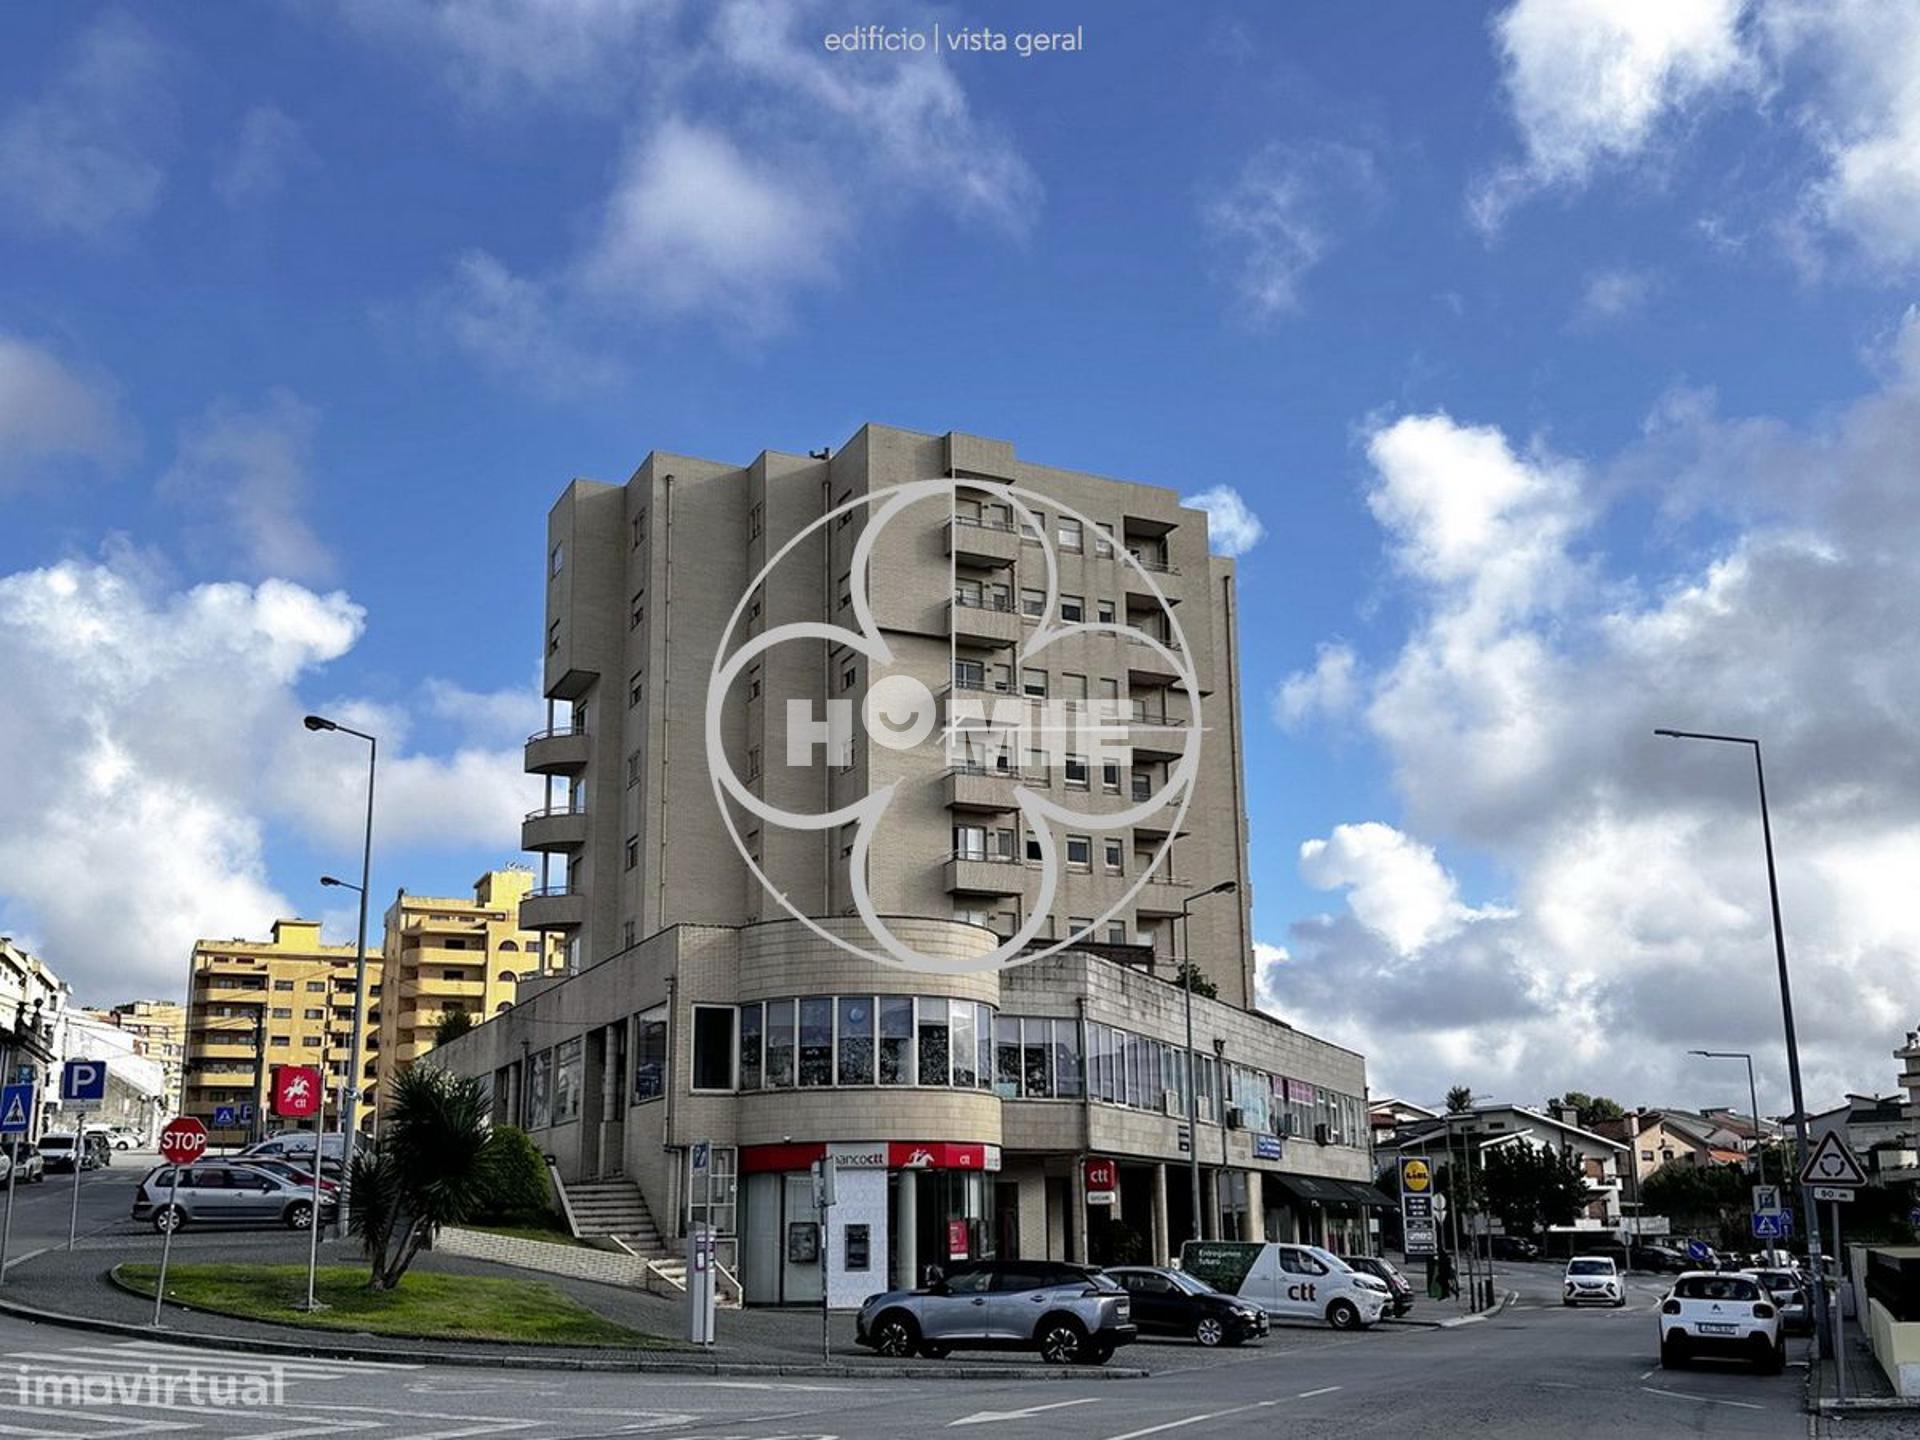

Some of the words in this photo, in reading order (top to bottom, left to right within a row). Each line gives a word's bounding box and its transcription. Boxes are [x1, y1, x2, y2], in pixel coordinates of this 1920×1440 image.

[71, 1065, 97, 1097] P
[162, 1131, 206, 1150] STOP
[1090, 1169, 1109, 1183] ctt
[1288, 1282, 1317, 1301] ctt
